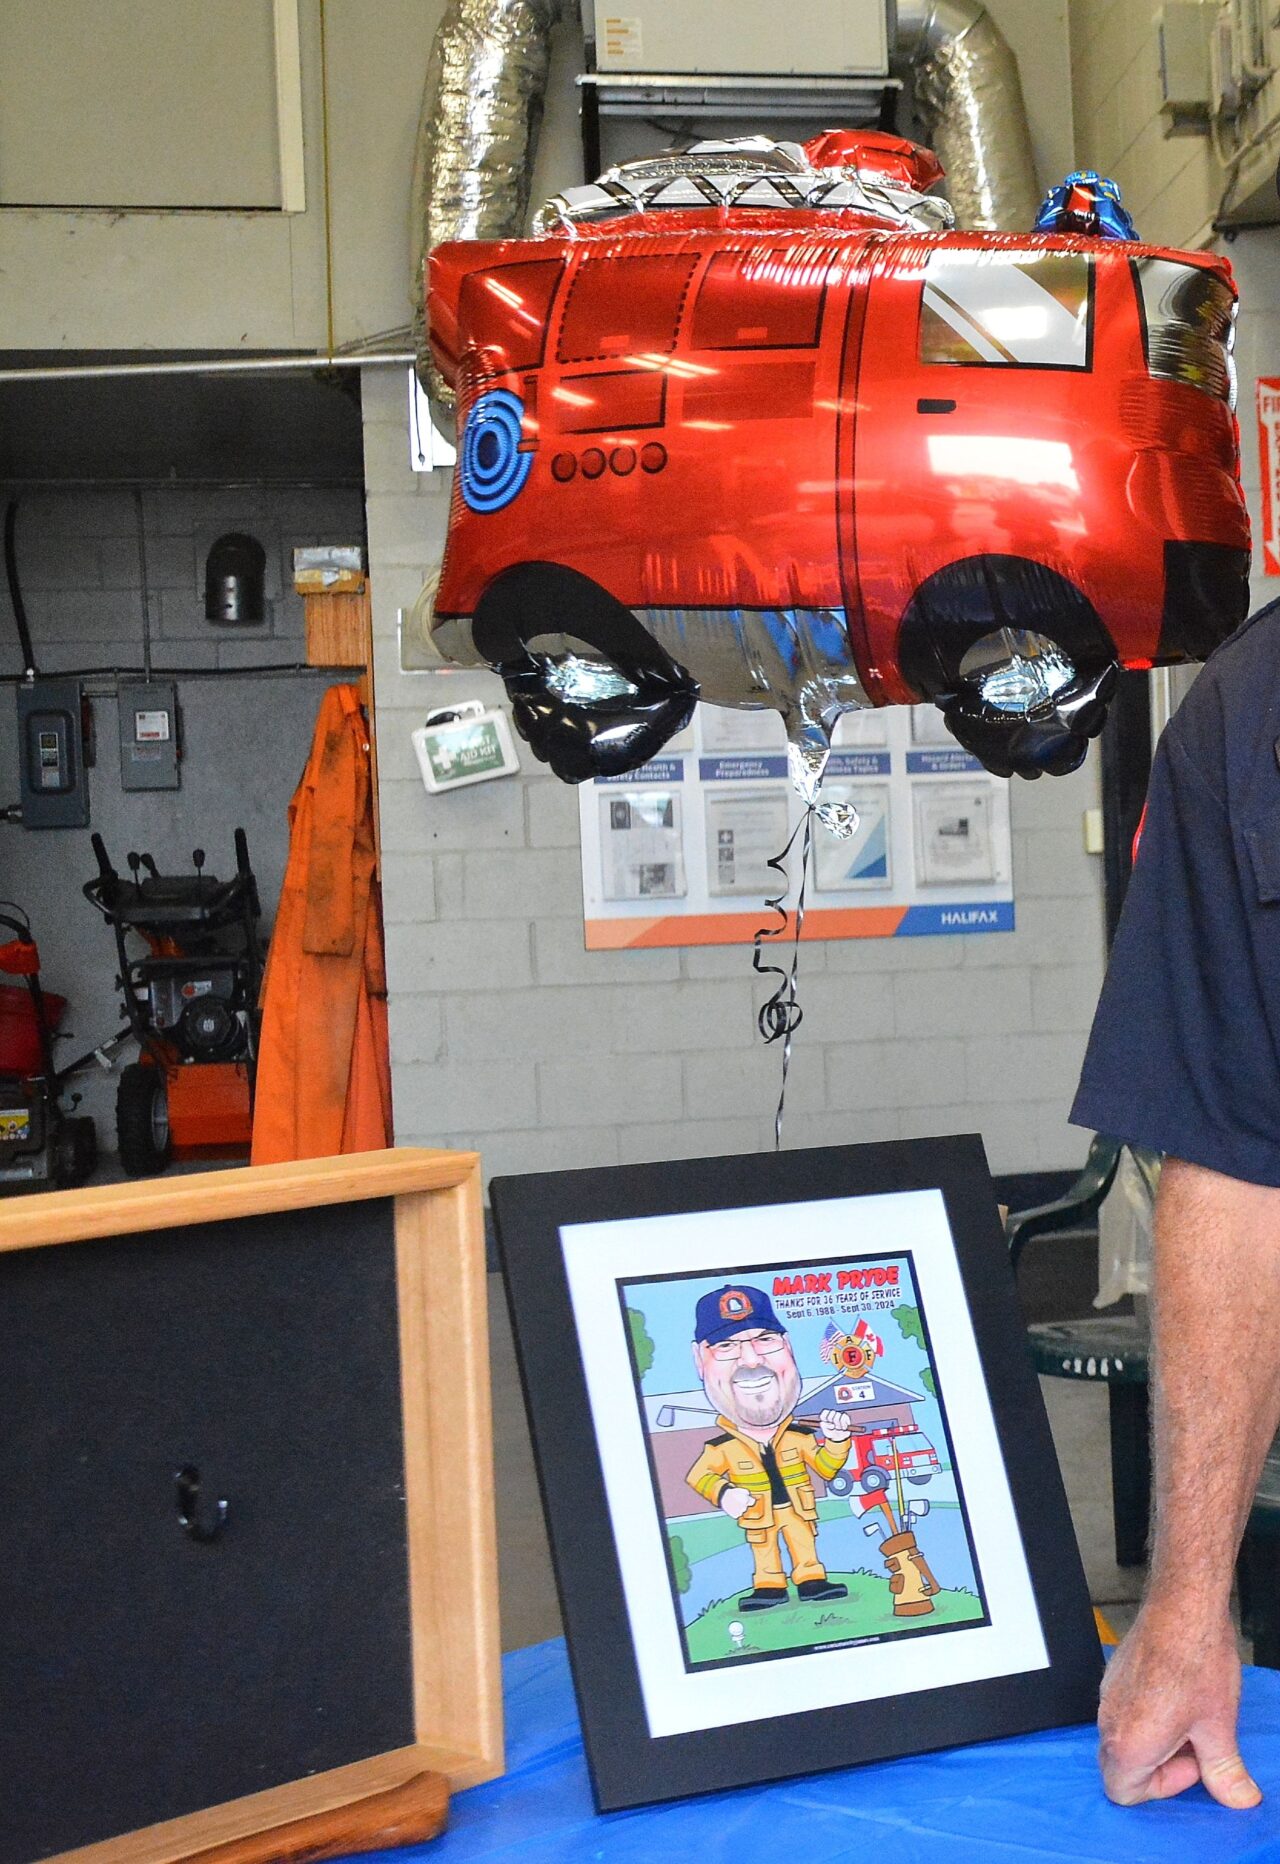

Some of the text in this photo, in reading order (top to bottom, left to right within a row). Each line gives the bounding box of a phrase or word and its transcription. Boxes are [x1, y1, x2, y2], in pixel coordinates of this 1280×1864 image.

[941, 910, 999, 925] HALIFAX
[773, 1265, 900, 1296] MARK PRYDE
[775, 1287, 901, 1310] THANKS FOR 36 YEARS OF SERVICE
[786, 1308, 806, 1319] Sept
[816, 1305, 836, 1316] 1988
[841, 1303, 860, 1314] Sept
[875, 1299, 895, 1310] 2024
[859, 1390, 866, 1399] 4
